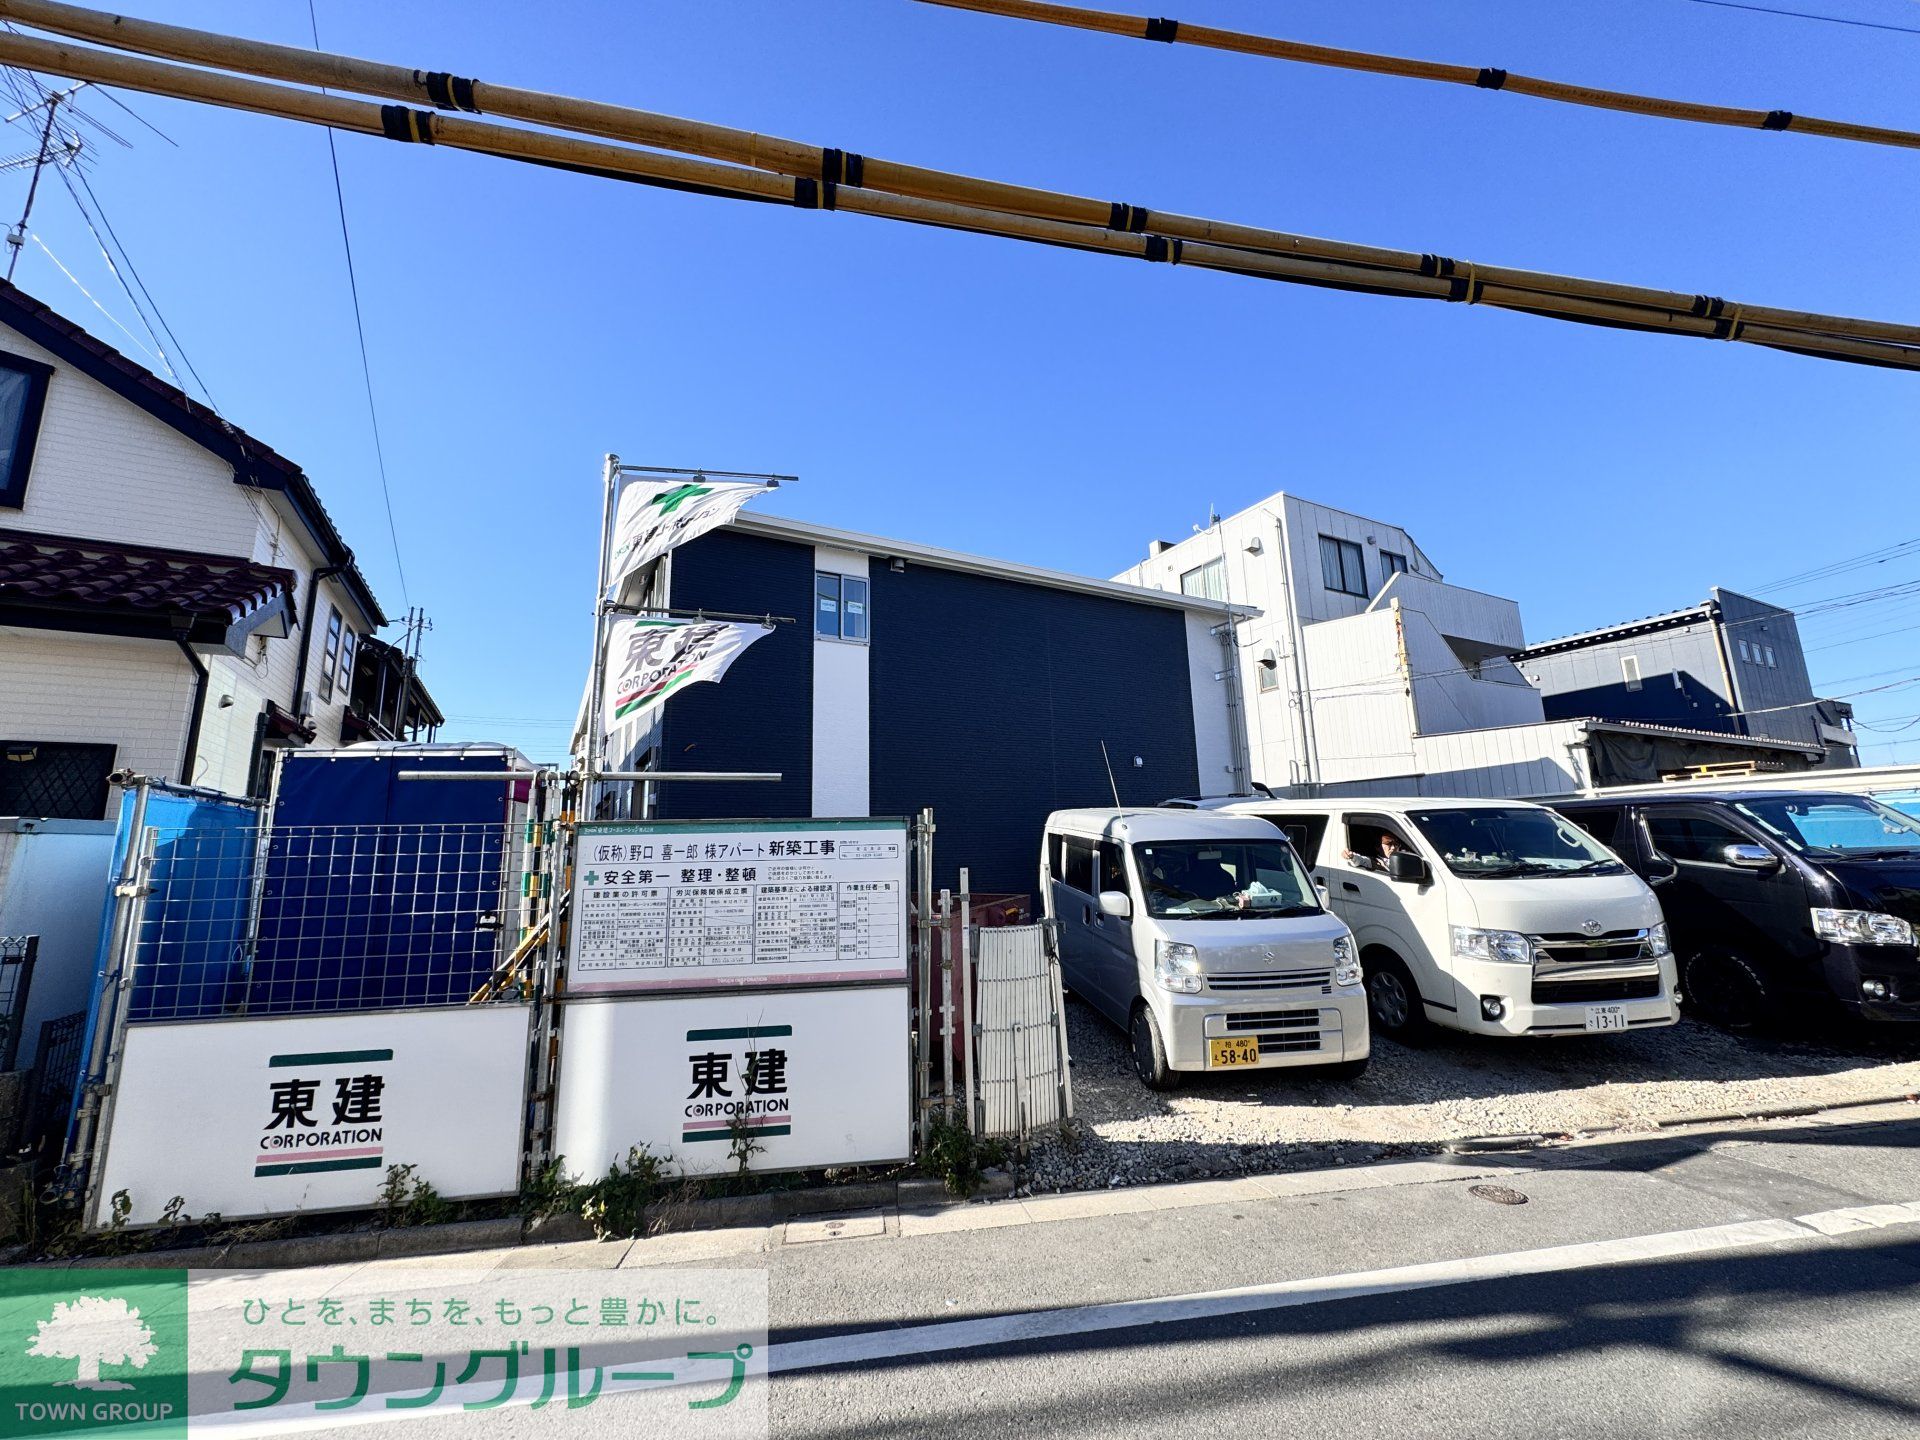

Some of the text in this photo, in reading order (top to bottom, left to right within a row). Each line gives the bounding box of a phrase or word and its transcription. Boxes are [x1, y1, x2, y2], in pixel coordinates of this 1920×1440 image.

[618, 624, 731, 680] 東建
[661, 842, 699, 862] 喜一郎
[768, 840, 836, 857] 新築工事
[603, 866, 757, 886] 安全第一 整理・整頓
[593, 890, 658, 899] 建設業の許可票
[675, 887, 748, 897] 労災保険関係成立票
[760, 884, 834, 894] 建築基準法による確認済
[846, 883, 891, 892] 作業主任者一覧
[1607, 1006, 1619, 1014] 400
[1596, 1014, 1625, 1029] 13-11
[1235, 1039, 1248, 1048] 480
[1220, 1048, 1257, 1065] 58-40
[685, 1048, 788, 1100] 東建
[262, 1074, 386, 1130] 東建
[684, 1098, 790, 1118] CORPORATION
[260, 1128, 383, 1150] CORPORATION
